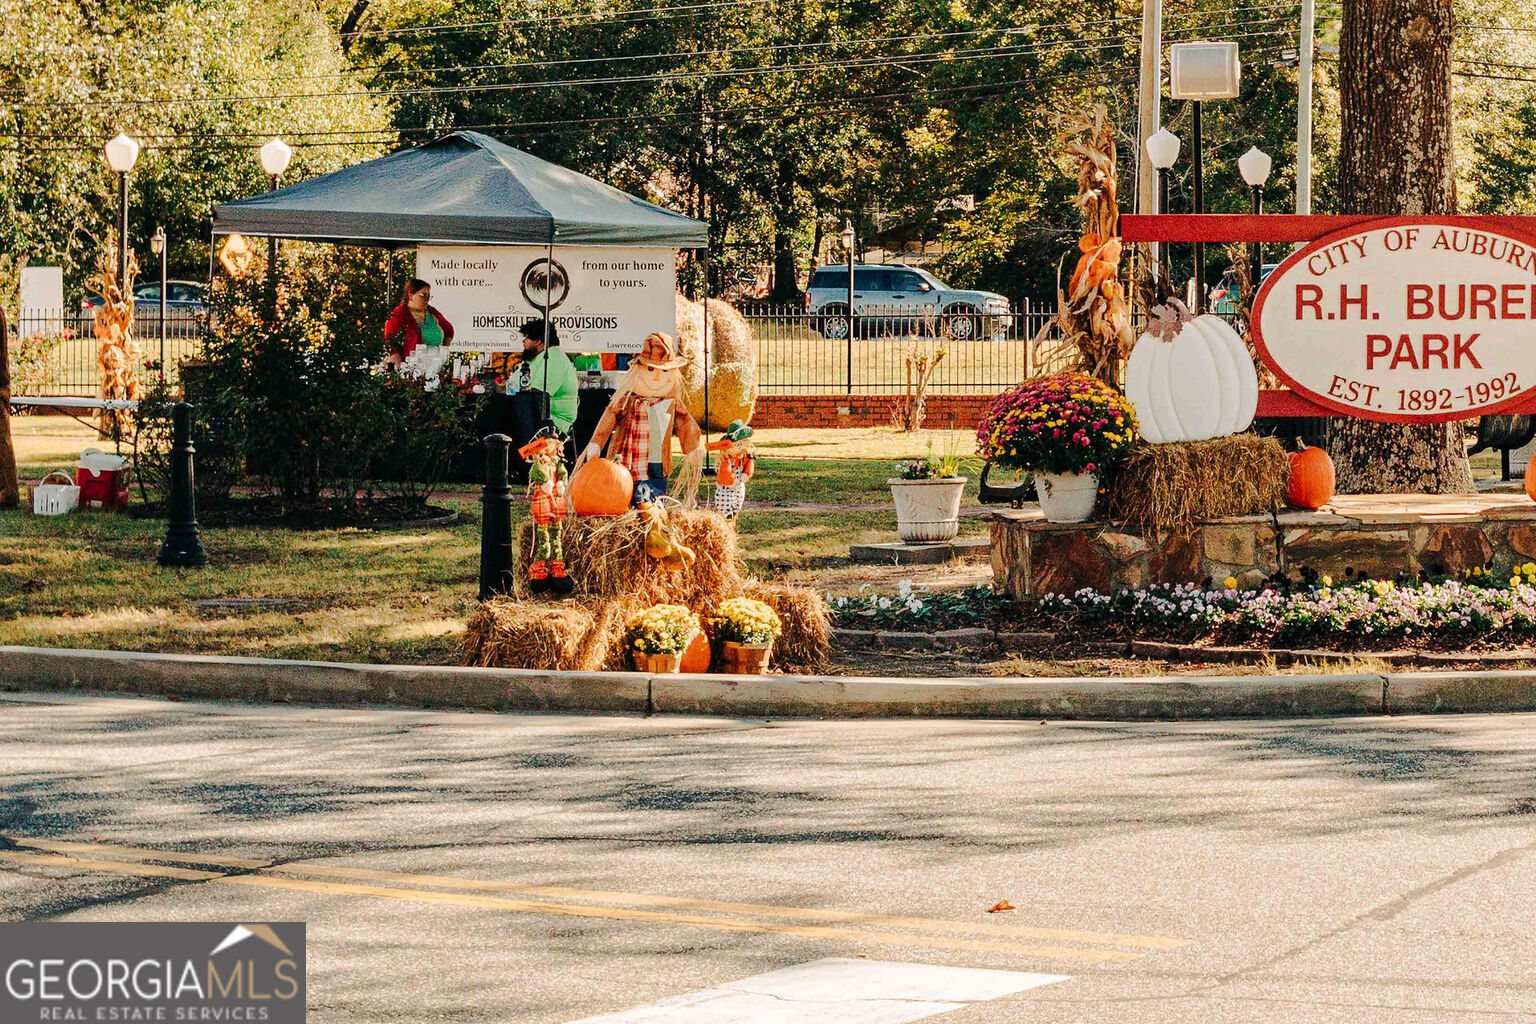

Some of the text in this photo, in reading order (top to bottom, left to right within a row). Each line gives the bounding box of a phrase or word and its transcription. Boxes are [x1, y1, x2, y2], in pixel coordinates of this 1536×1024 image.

[1308, 235, 1369, 276] CITY
[1383, 228, 1420, 252] OF
[431, 259, 498, 272] Made locally
[582, 260, 664, 270] from our home
[435, 277, 493, 286] with care...
[600, 278, 647, 289] to yours.
[1295, 284, 1380, 320] R.H.
[553, 316, 618, 329] PROVISIONS
[607, 341, 642, 349] Lawrence
[1366, 334, 1483, 370] PARK
[1327, 372, 1522, 411] EST. 1892-1992
